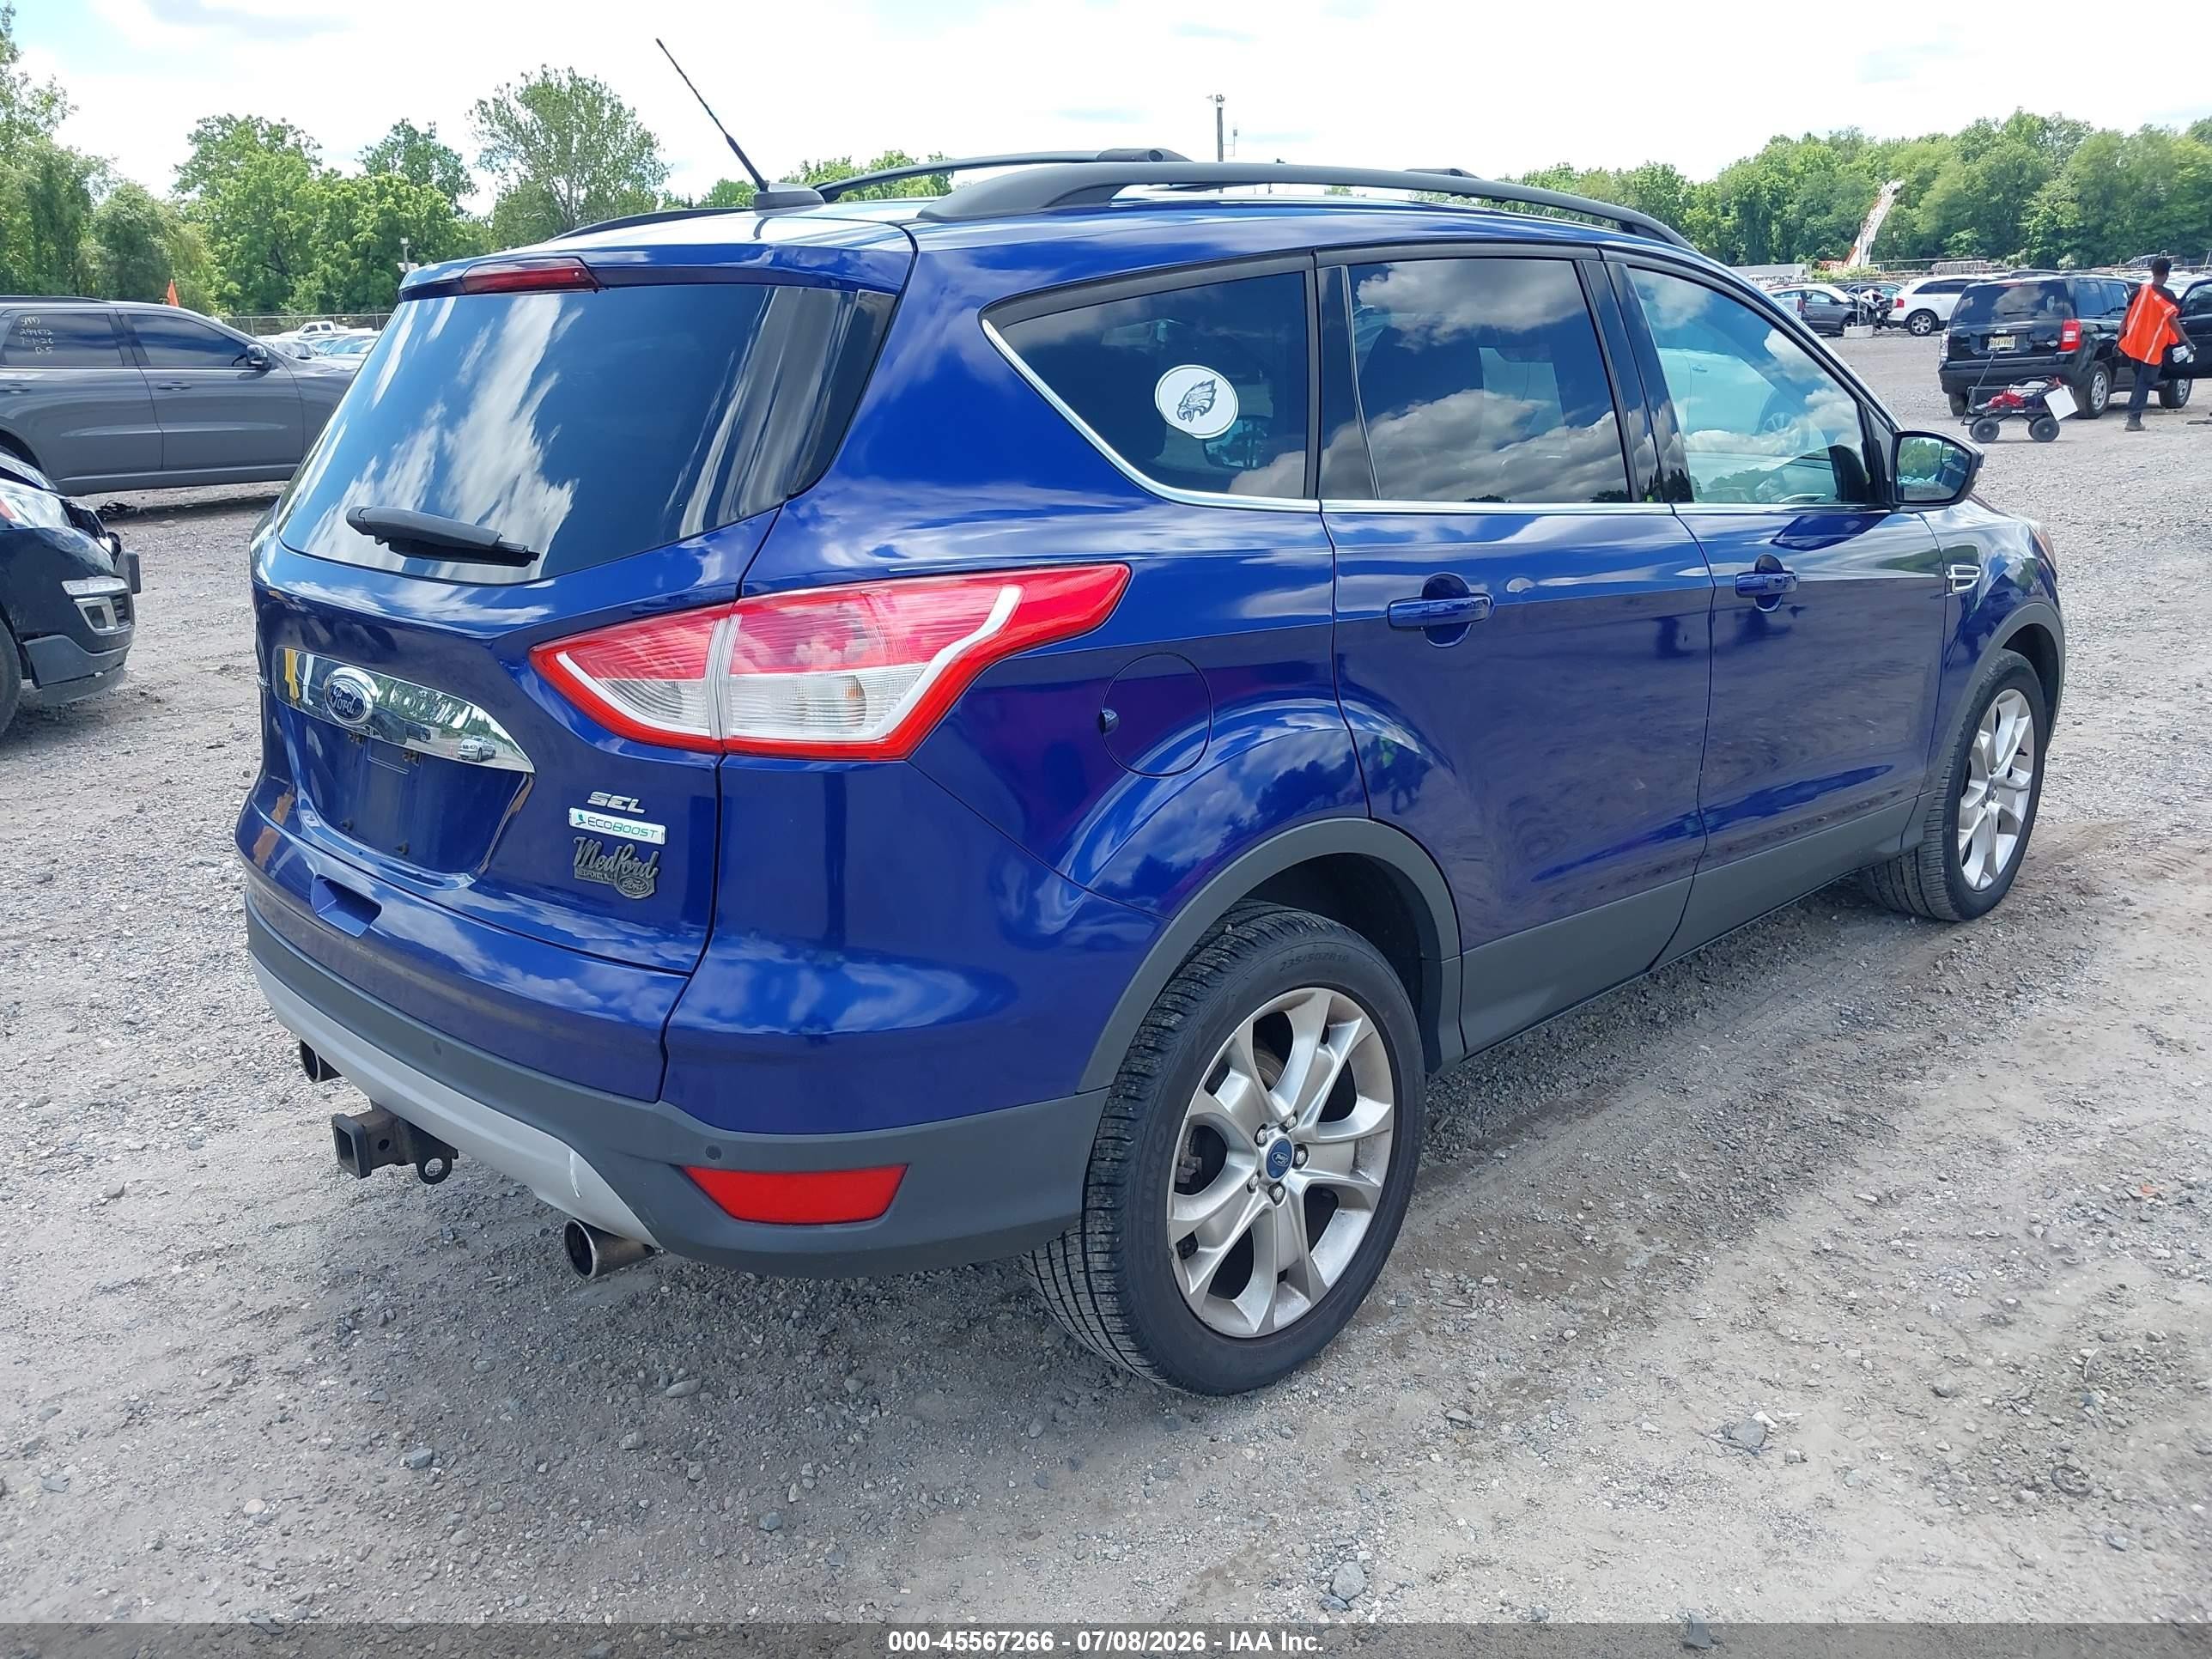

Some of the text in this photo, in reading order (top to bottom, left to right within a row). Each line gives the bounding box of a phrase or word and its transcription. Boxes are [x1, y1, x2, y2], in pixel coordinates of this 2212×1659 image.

[330, 685, 356, 714] Ford
[587, 791, 646, 814] SEL
[587, 816, 659, 839] ECOBOOST
[573, 836, 659, 879] Medford
